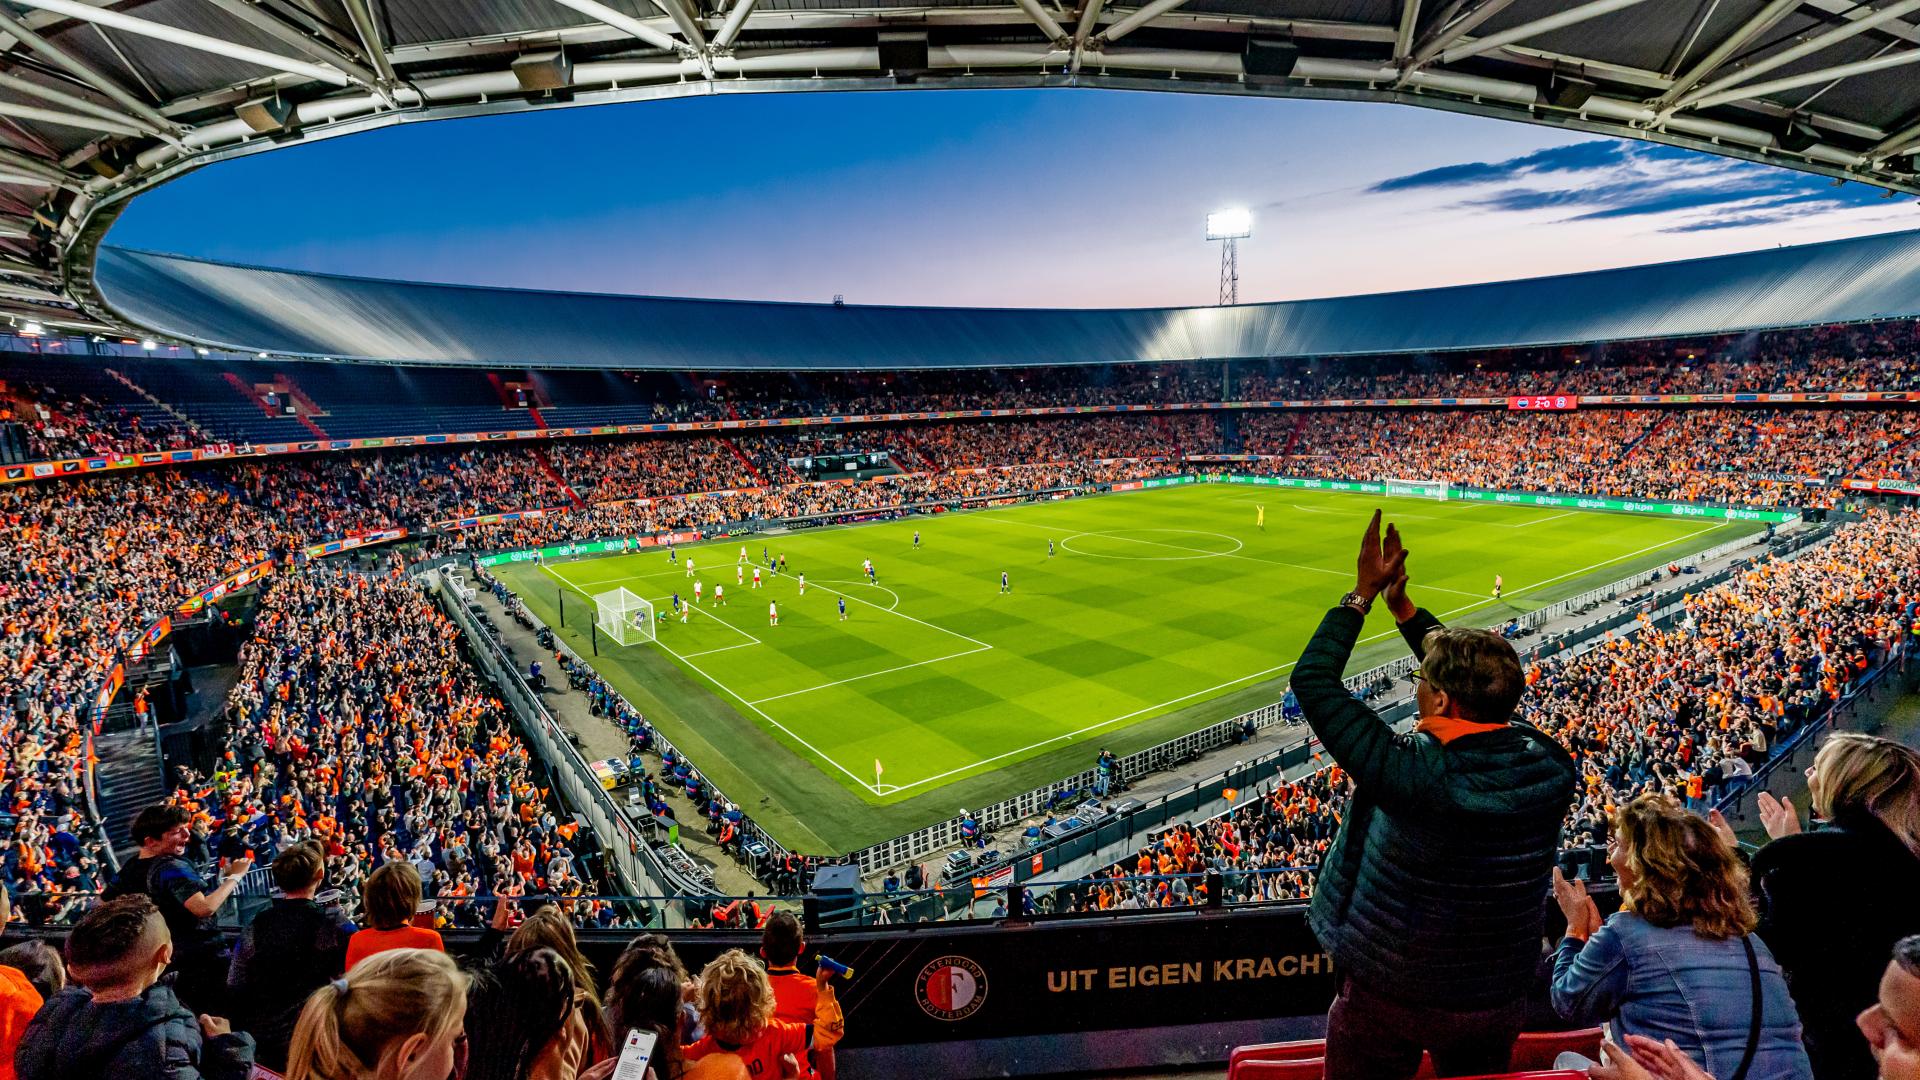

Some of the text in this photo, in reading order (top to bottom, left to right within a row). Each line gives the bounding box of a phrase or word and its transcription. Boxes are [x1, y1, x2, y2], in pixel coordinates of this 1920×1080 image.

[1534, 400, 1551, 409] 2-0
[1505, 494, 1520, 502] kpn
[1545, 496, 1562, 505] kpn
[1588, 499, 1606, 508] kpn
[1634, 502, 1653, 511] kpn
[1684, 506, 1704, 516] kpn
[1737, 509, 1760, 519] kpn
[921, 958, 982, 981] FEYENOORD
[1047, 969, 1098, 992] UIT
[1108, 961, 1202, 989] EIGEN
[922, 995, 983, 1018] ROTTERDAM
